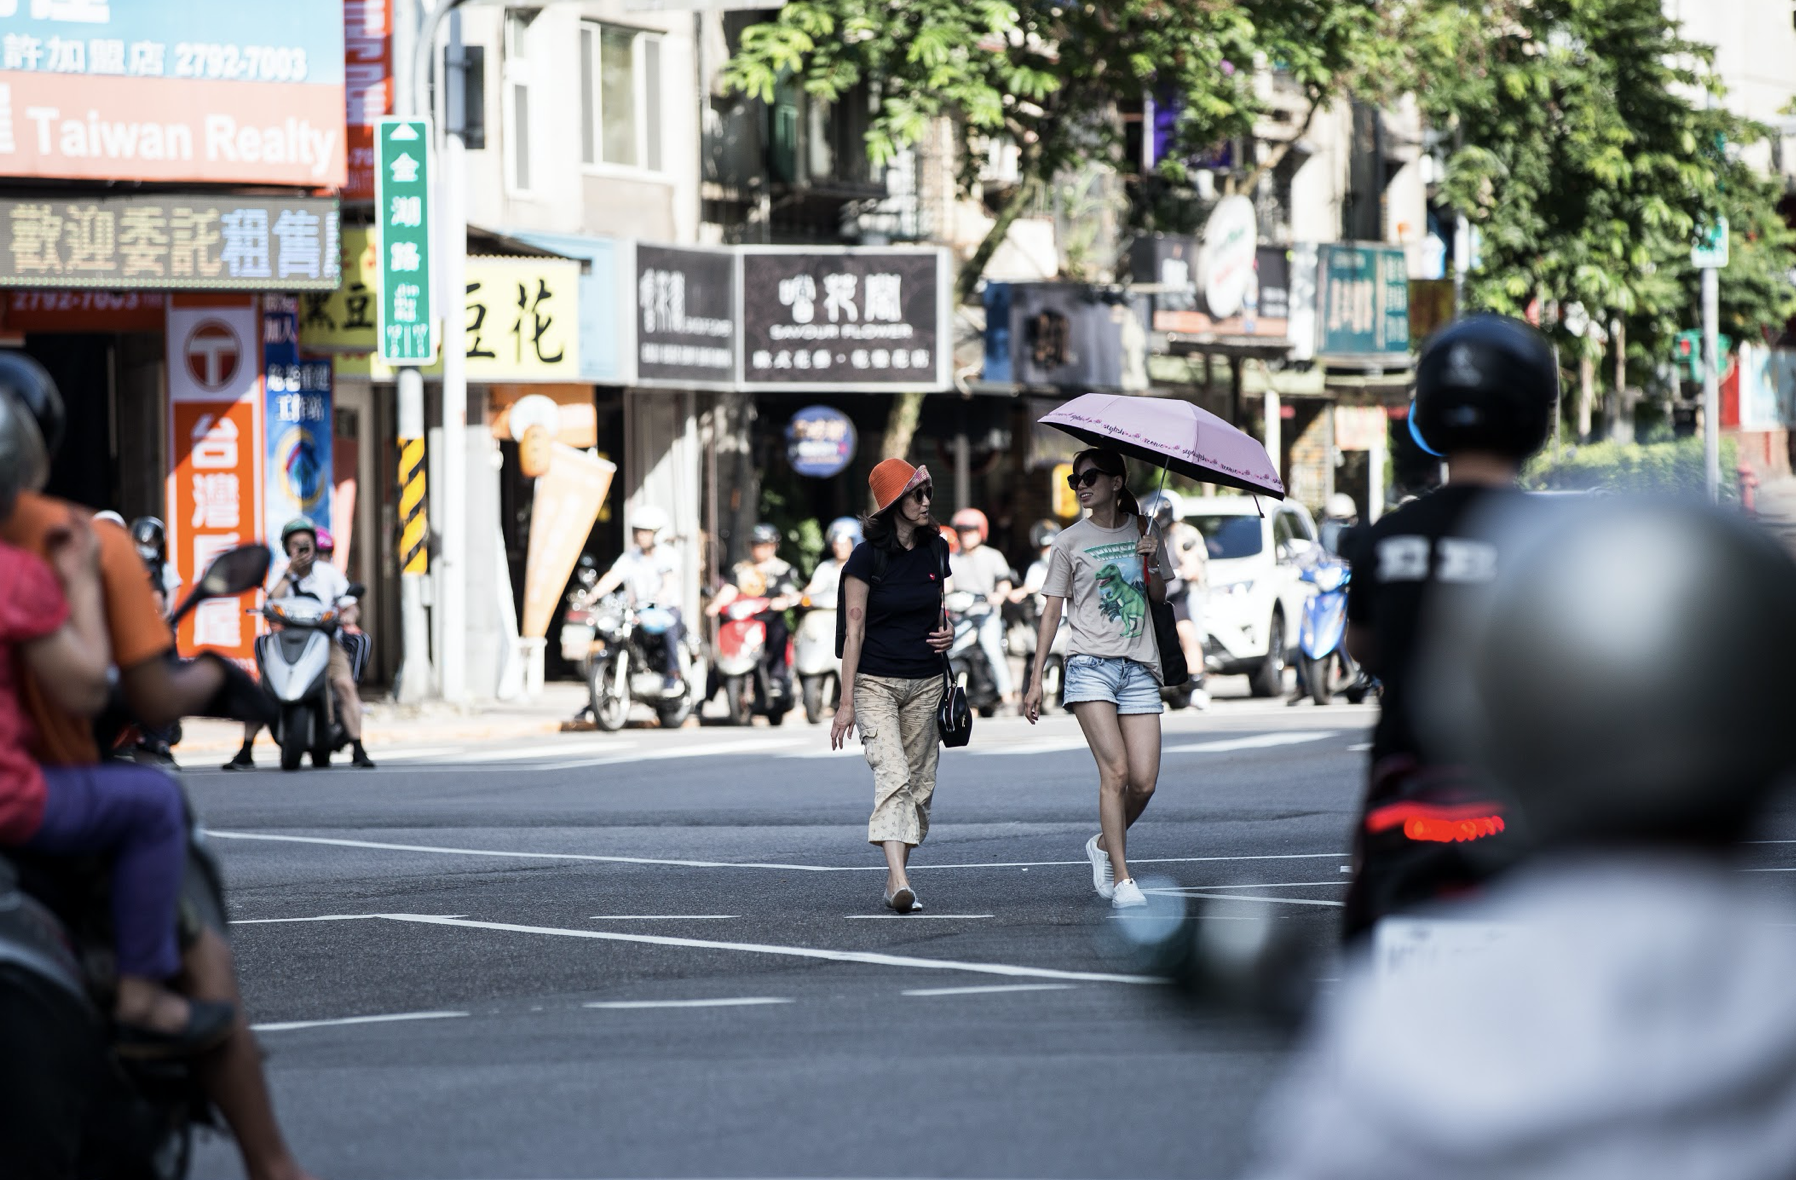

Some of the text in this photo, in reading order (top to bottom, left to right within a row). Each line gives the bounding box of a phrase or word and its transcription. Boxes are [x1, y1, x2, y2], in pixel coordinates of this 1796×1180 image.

[2, 32, 308, 82] 許加盟店 2792-7003
[26, 106, 194, 161] Taiwan
[204, 114, 338, 177] Realty
[389, 151, 422, 272] 金湖路
